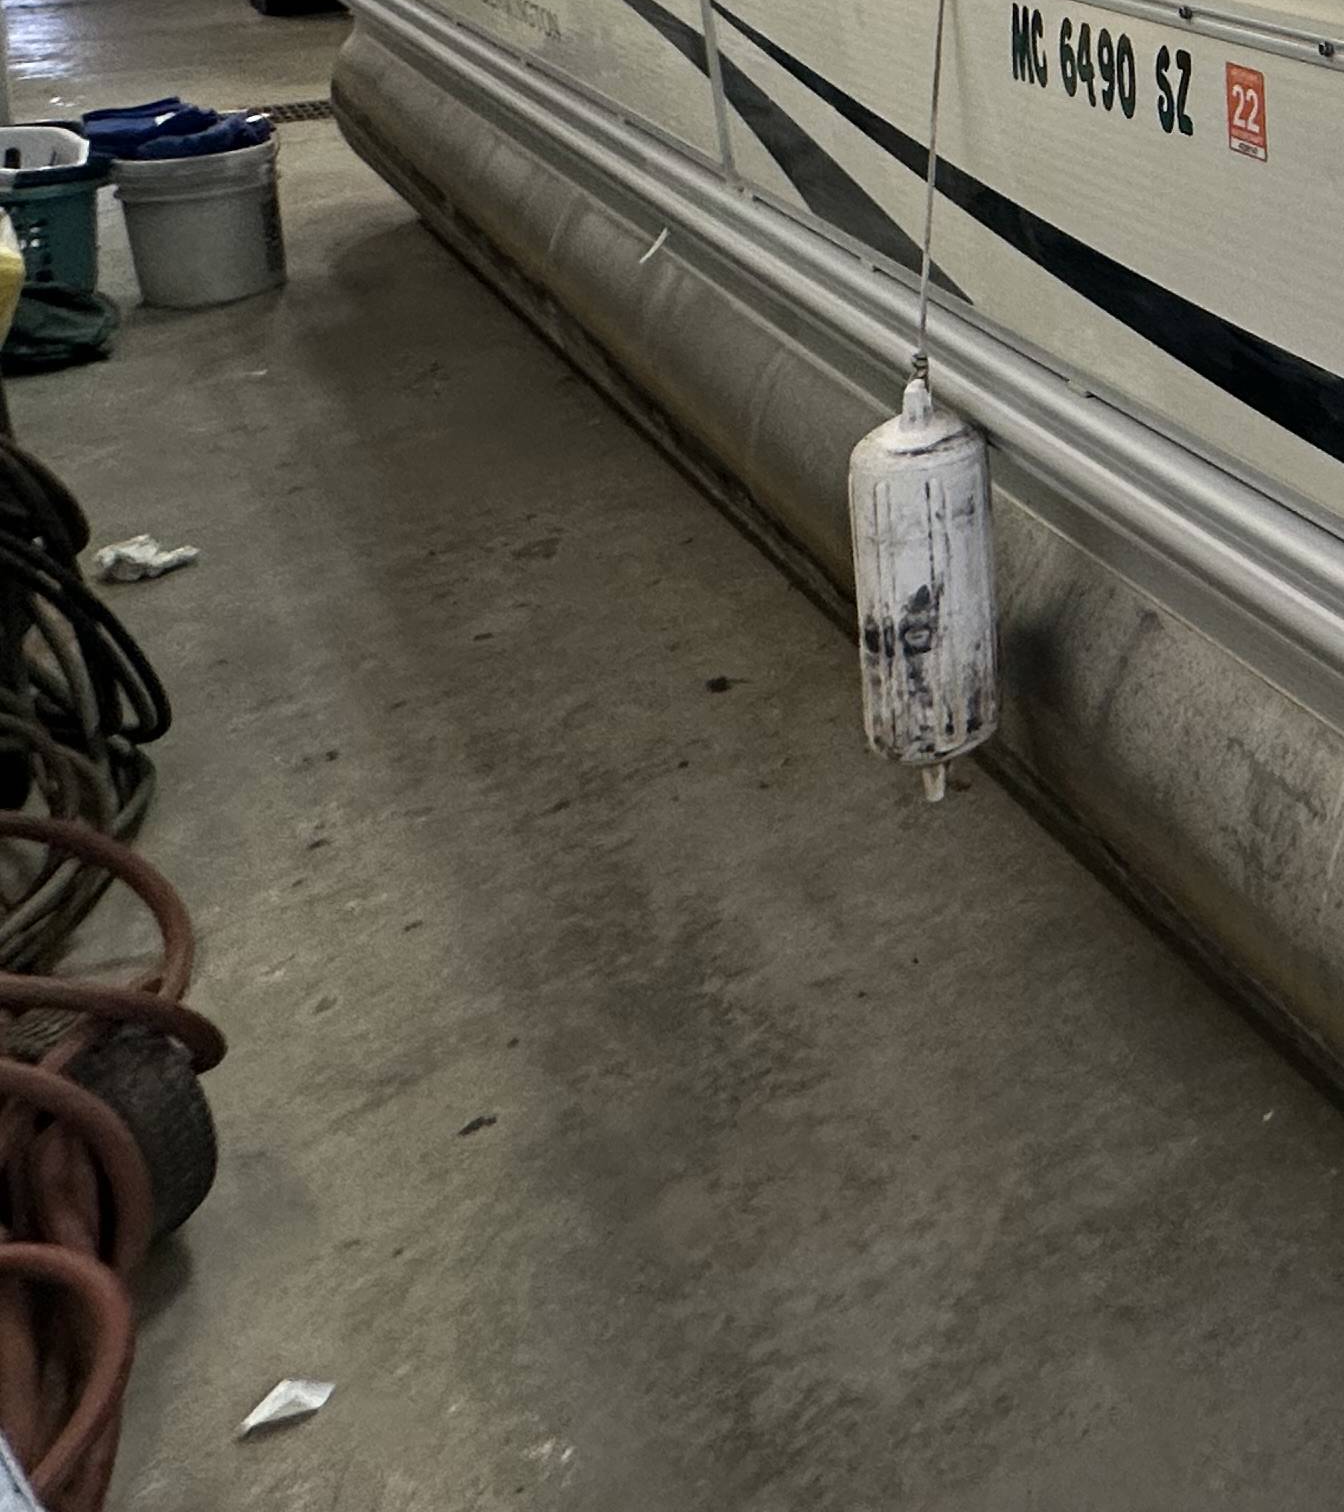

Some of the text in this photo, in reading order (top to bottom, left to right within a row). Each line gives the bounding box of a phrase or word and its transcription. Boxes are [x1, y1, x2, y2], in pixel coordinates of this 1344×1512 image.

[1012, 2, 1194, 136] MC 6490 SZ
[1232, 84, 1260, 134] 22
